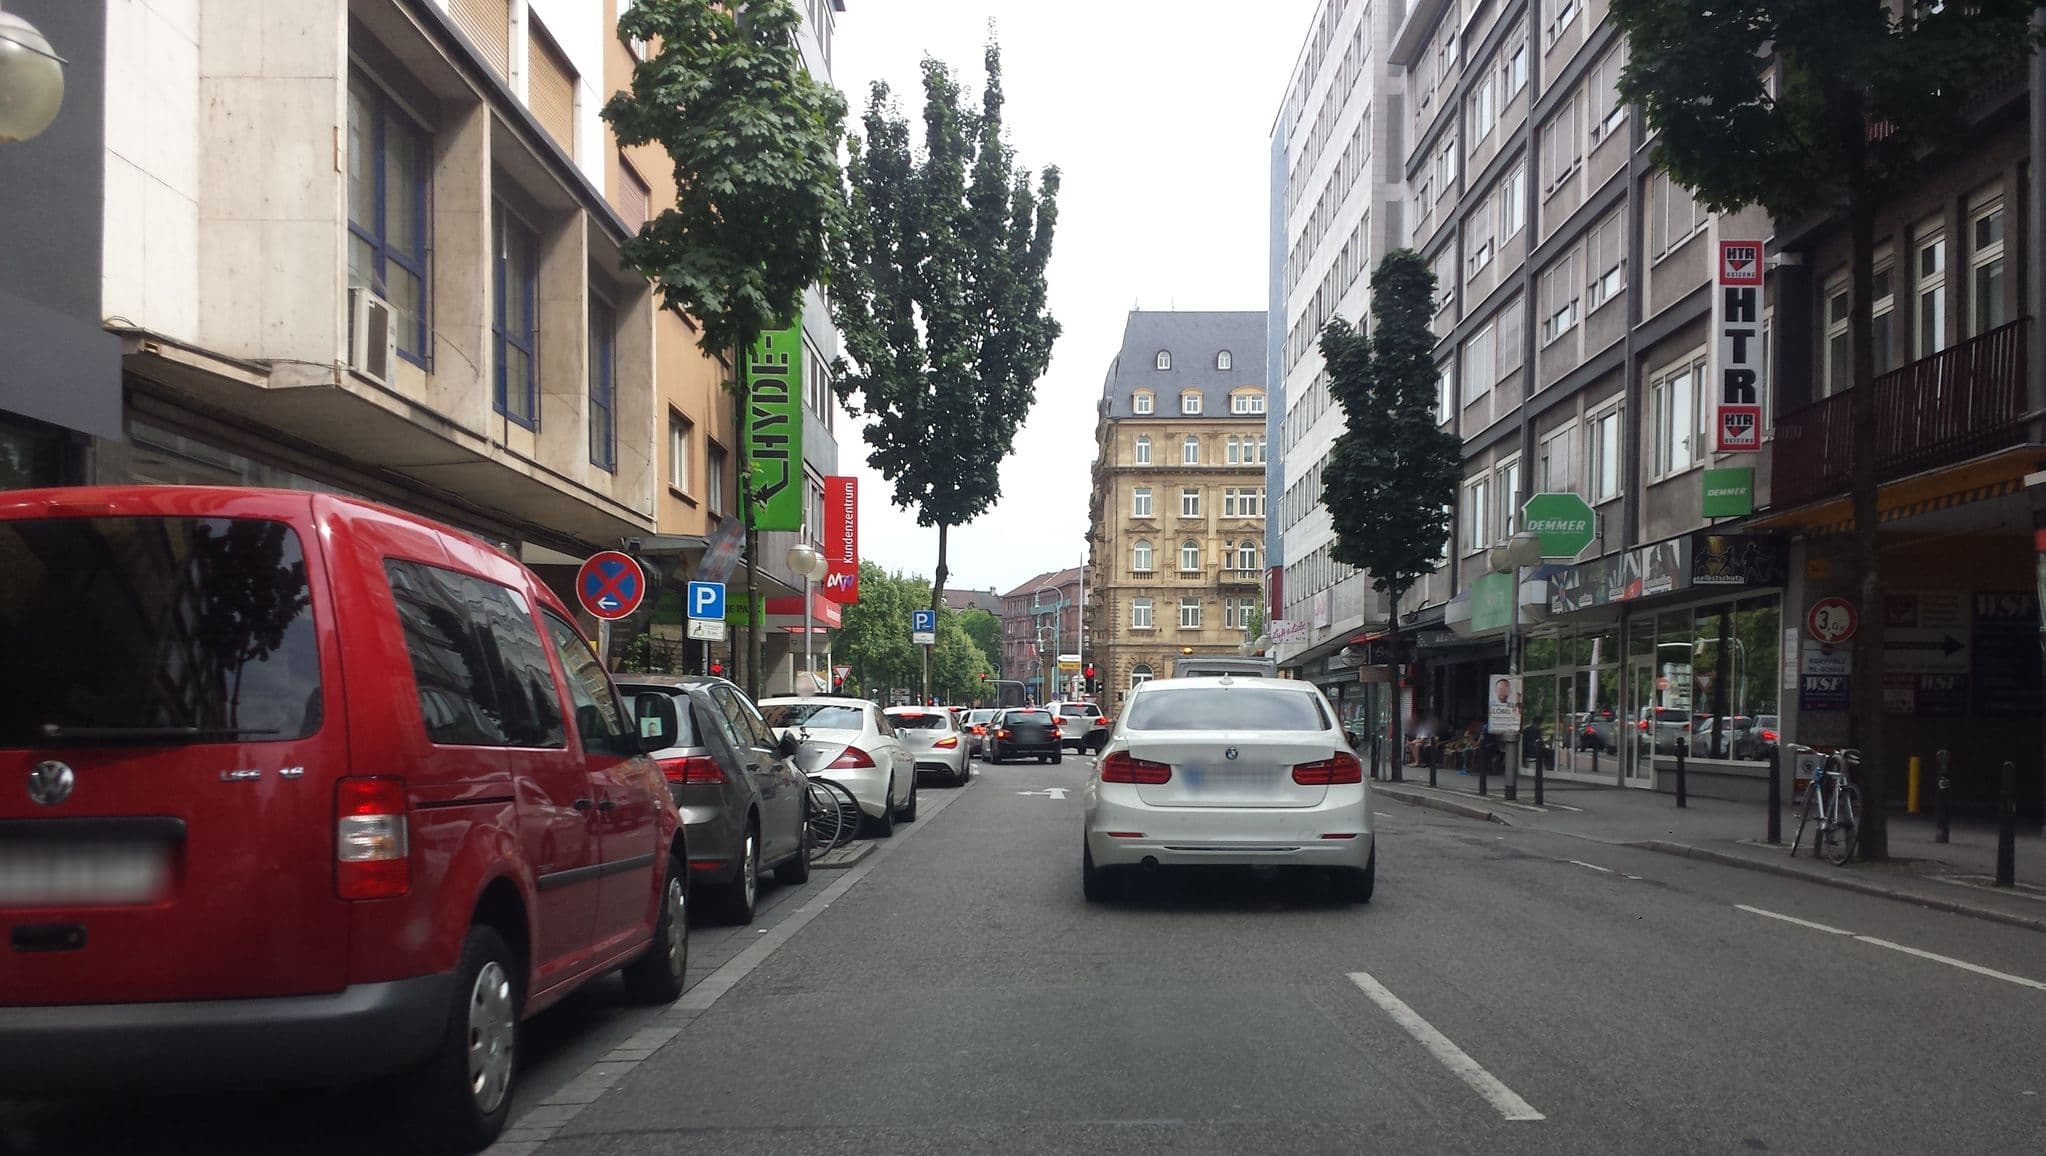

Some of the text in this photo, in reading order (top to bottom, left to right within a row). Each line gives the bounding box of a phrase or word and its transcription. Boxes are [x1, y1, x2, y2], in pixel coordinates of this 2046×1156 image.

[1727, 247, 1756, 260] HTR
[1724, 287, 1757, 405] HTR
[751, 334, 790, 460] HYDE-
[1724, 414, 1754, 426] HTR
[1707, 487, 1748, 497] DEMMER
[842, 482, 854, 564] Kundenzentrum
[1527, 519, 1587, 531] DEMMER
[696, 586, 717, 614] P
[915, 612, 929, 630] P
